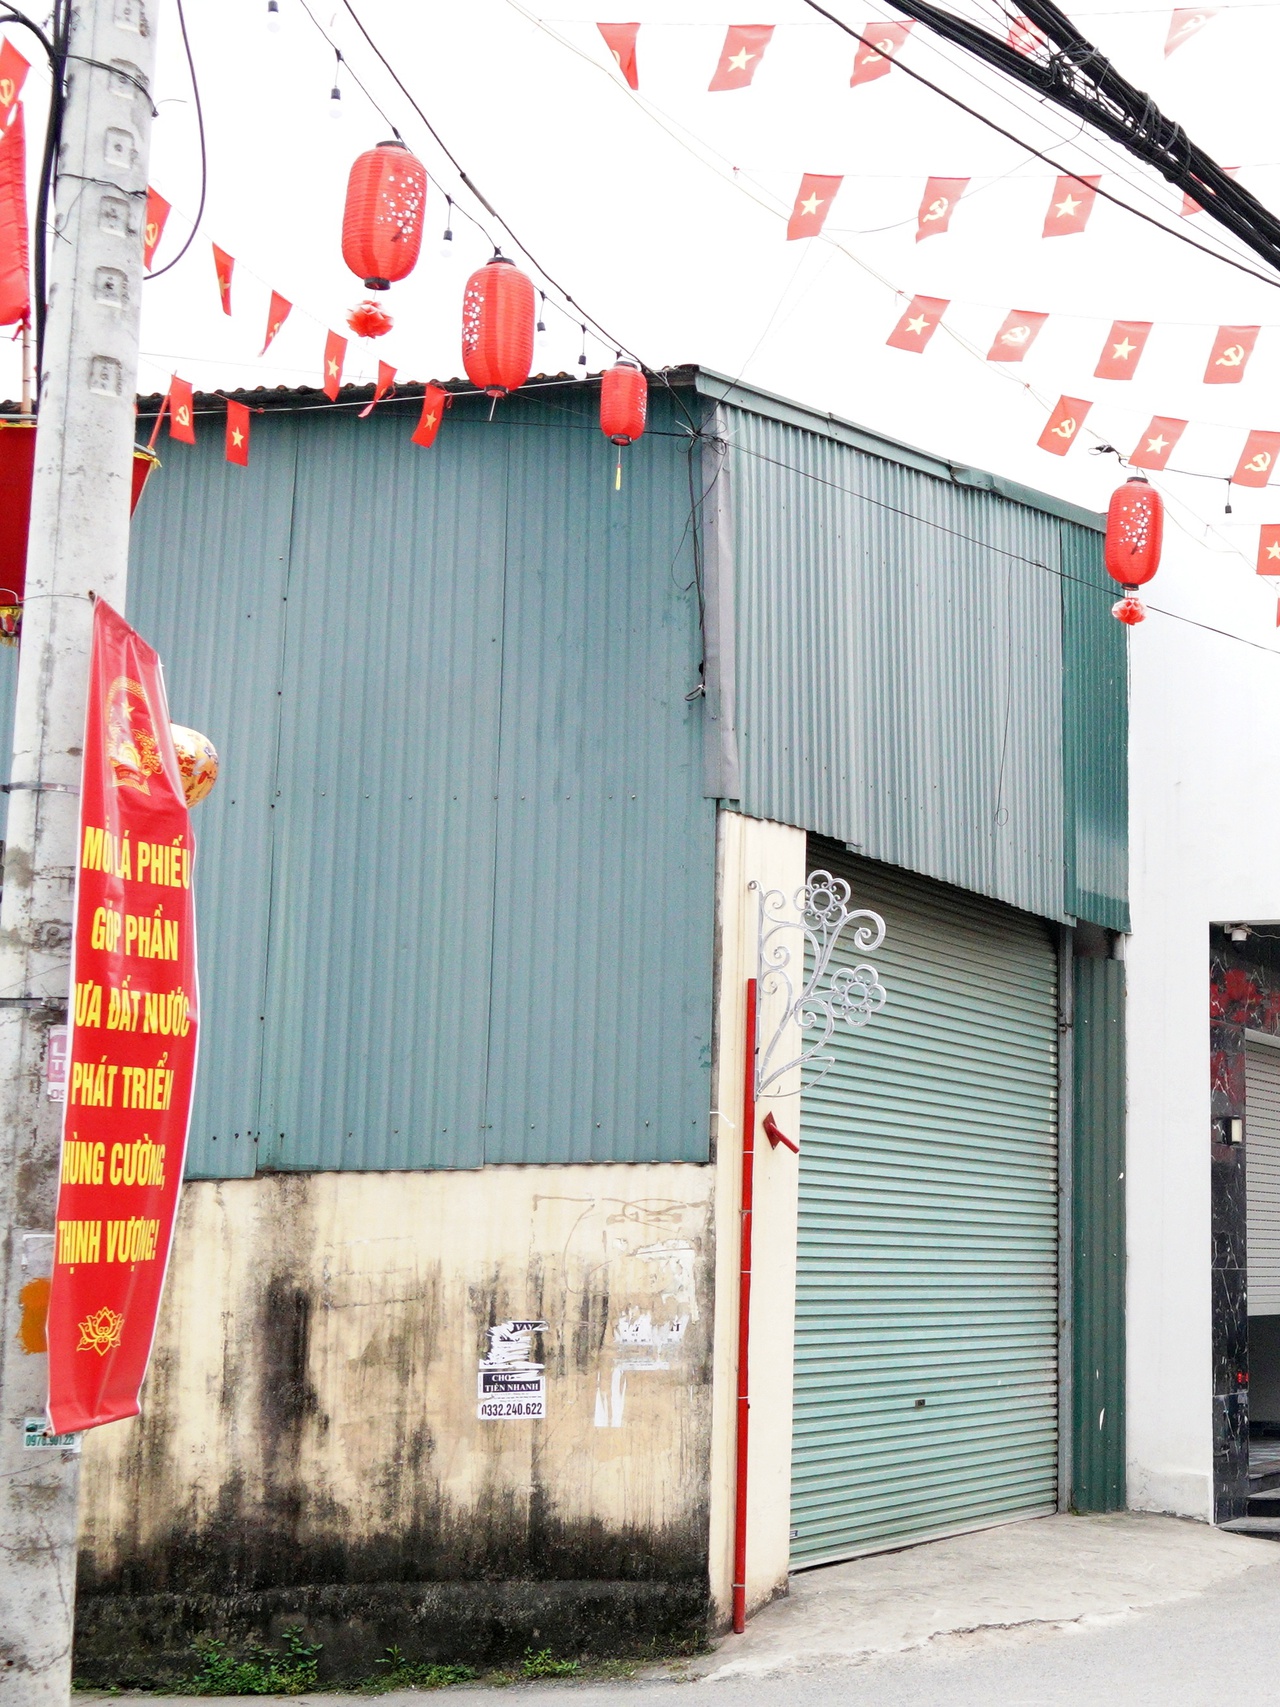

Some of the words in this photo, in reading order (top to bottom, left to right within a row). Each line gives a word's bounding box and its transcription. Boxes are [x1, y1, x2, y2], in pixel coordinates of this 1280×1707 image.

[114, 830, 132, 881] LÁ
[137, 834, 190, 890] PHIẾU
[91, 900, 121, 953] GÓP
[125, 904, 178, 960] PHẦN
[75, 980, 103, 1028] ƯA
[106, 975, 142, 1032] ĐẤT
[143, 986, 191, 1037] NƯỚC
[71, 1055, 119, 1107] PHÁT
[122, 1052, 175, 1111] TRIỂN
[62, 1132, 106, 1185] HÙNG
[110, 1134, 166, 1191] CƯỜNG,
[58, 1220, 102, 1274] THỊNH
[481, 1402, 543, 1417] 0332.240.622
[485, 1383, 506, 1392] TIỀN
[507, 1383, 539, 1391] NHANH
